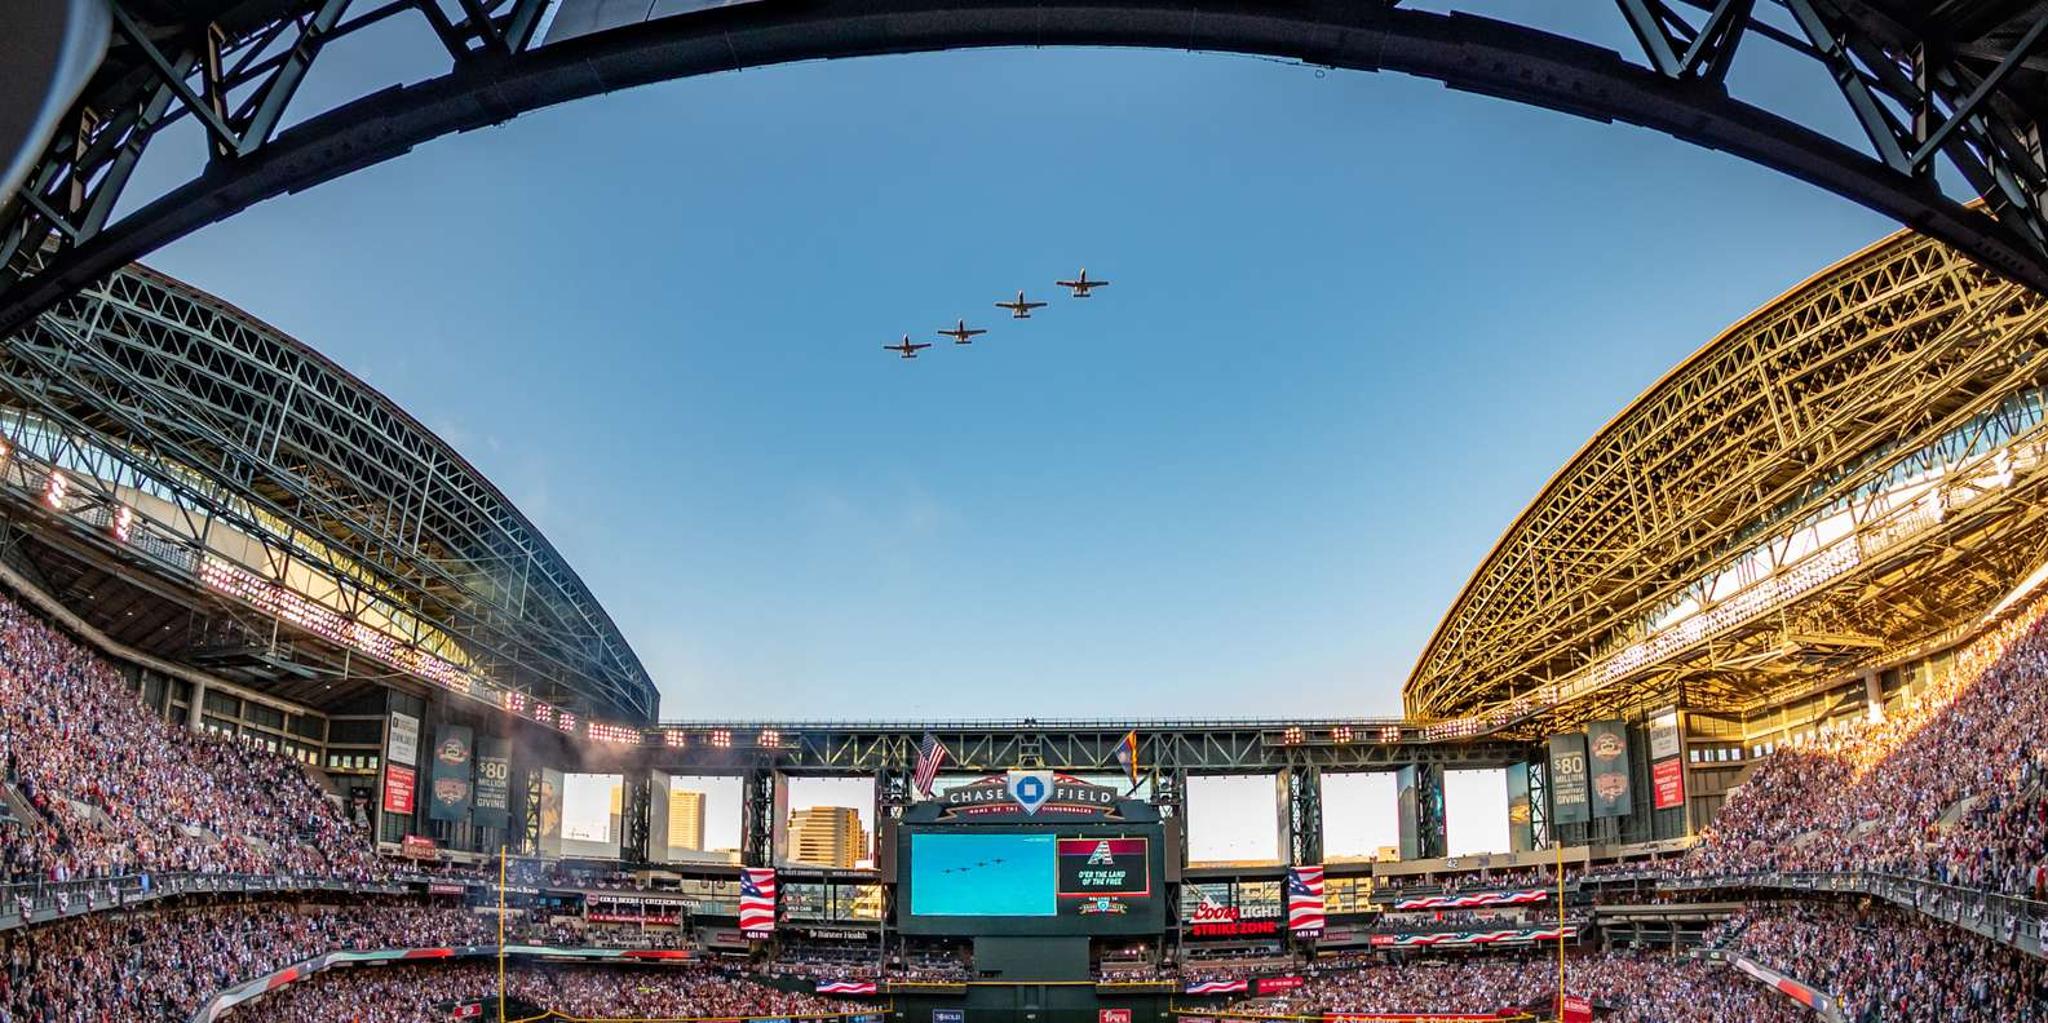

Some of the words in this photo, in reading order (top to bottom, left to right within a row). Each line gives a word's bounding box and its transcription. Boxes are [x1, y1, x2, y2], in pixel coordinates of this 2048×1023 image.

[479, 762, 507, 780] $80
[1554, 756, 1584, 775] $80
[478, 777, 507, 787] MILLION
[1555, 773, 1584, 784] MILLION
[950, 789, 1004, 804] CHASE
[1057, 788, 1111, 803] FIELD
[1557, 793, 1585, 805] GIVING
[477, 797, 506, 809] GIVING
[1078, 870, 1093, 878] O'ER
[1082, 878, 1091, 886] OF
[1092, 878, 1105, 886] THE
[1106, 878, 1122, 886] FREE
[1194, 902, 1240, 920] Coors
[1240, 905, 1282, 919] LIGHT
[1192, 923, 1237, 936] STRIKE
[1240, 921, 1276, 934] ZONE
[817, 930, 842, 939] Banner
[843, 930, 869, 940] Health
